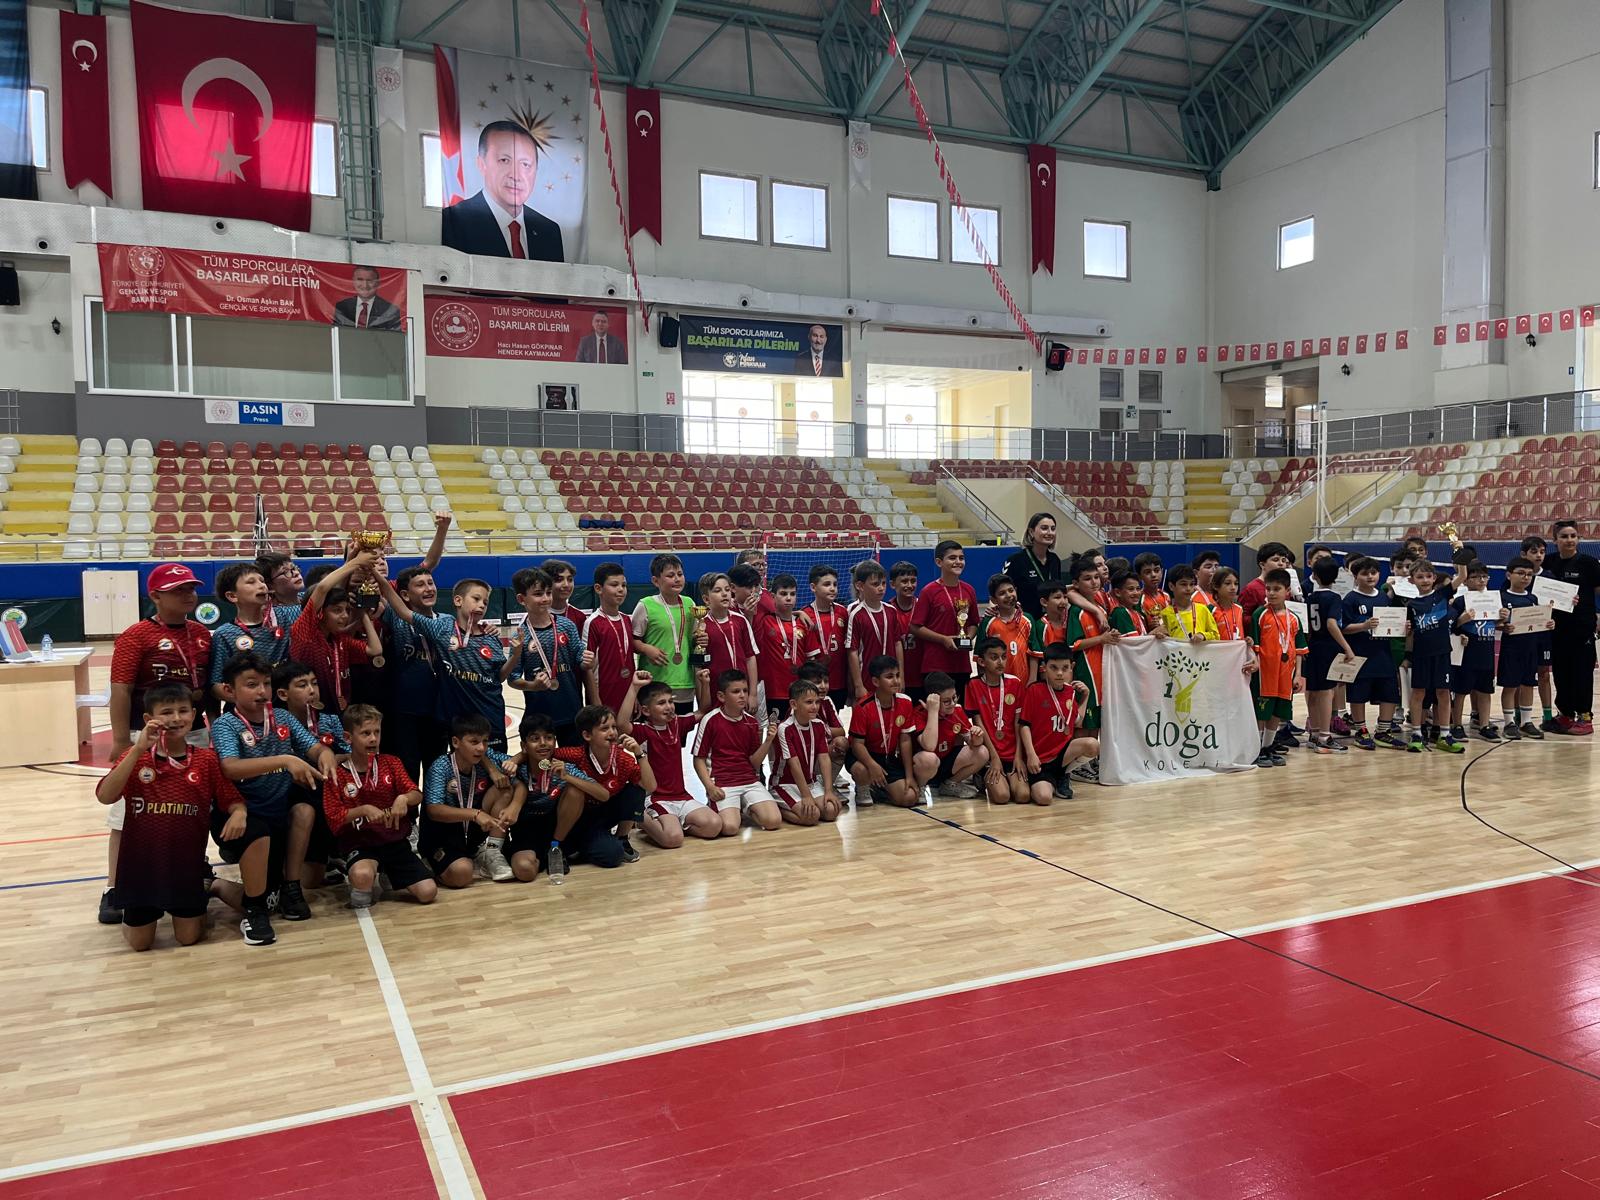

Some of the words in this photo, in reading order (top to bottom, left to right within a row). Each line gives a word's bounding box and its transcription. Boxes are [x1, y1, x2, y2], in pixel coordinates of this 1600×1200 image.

[201, 255, 228, 268] TÜM
[232, 258, 315, 275] SPORCULARA
[196, 269, 269, 285] BAŞARILAR
[273, 274, 320, 290] DİLERİM
[236, 295, 259, 303] Osman
[261, 297, 278, 305] Aşkın
[280, 299, 294, 307] BAK
[259, 305, 279, 314] SPOR
[492, 305, 509, 316] TÜM
[511, 308, 566, 319] SPORCULARA
[489, 319, 536, 331] BAŞARILAR
[538, 321, 570, 333] DİLERİM
[703, 325, 720, 335] TÜM
[720, 327, 784, 339] SPORCULARIMIZA
[687, 335, 752, 349] BAŞARILAR
[753, 337, 799, 351] DİLERİM
[243, 405, 278, 415] BASIN
[1310, 603, 1321, 631] 5
[830, 634, 839, 652] 5
[1009, 640, 1018, 656] 9
[1543, 650, 1551, 660] 10
[1051, 715, 1066, 733] 10
[1145, 710, 1219, 759] doğa
